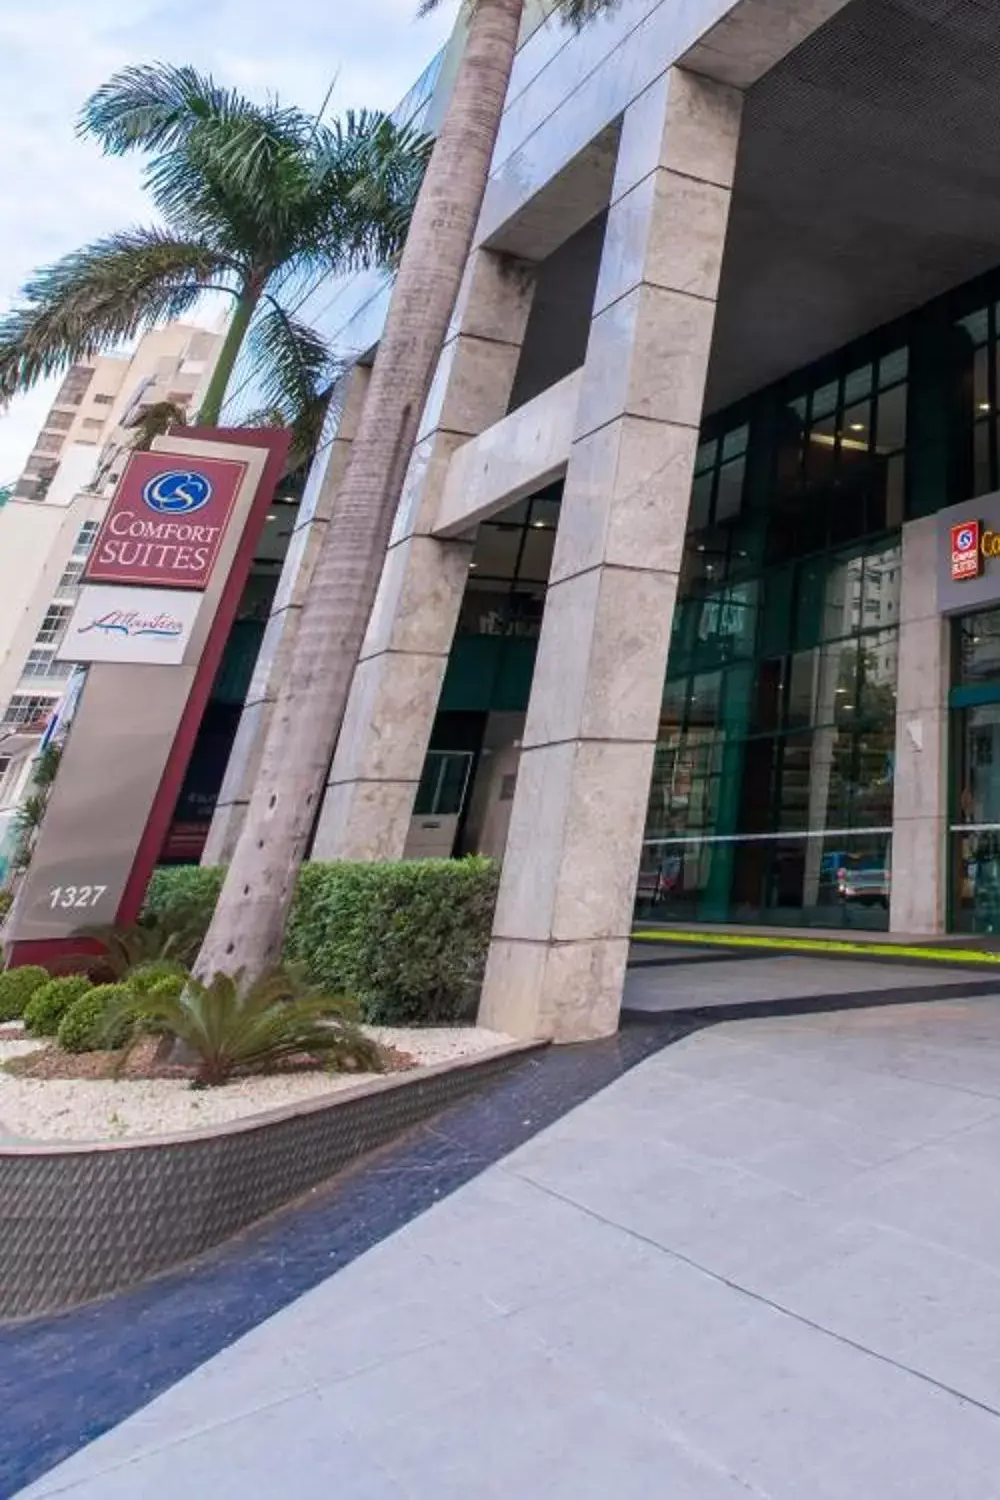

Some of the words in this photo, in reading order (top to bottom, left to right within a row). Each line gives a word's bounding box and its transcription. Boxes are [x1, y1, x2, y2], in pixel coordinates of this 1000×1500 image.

[109, 510, 220, 543] COMFORT
[99, 539, 209, 571] SUITES
[50, 885, 108, 910] 1327
